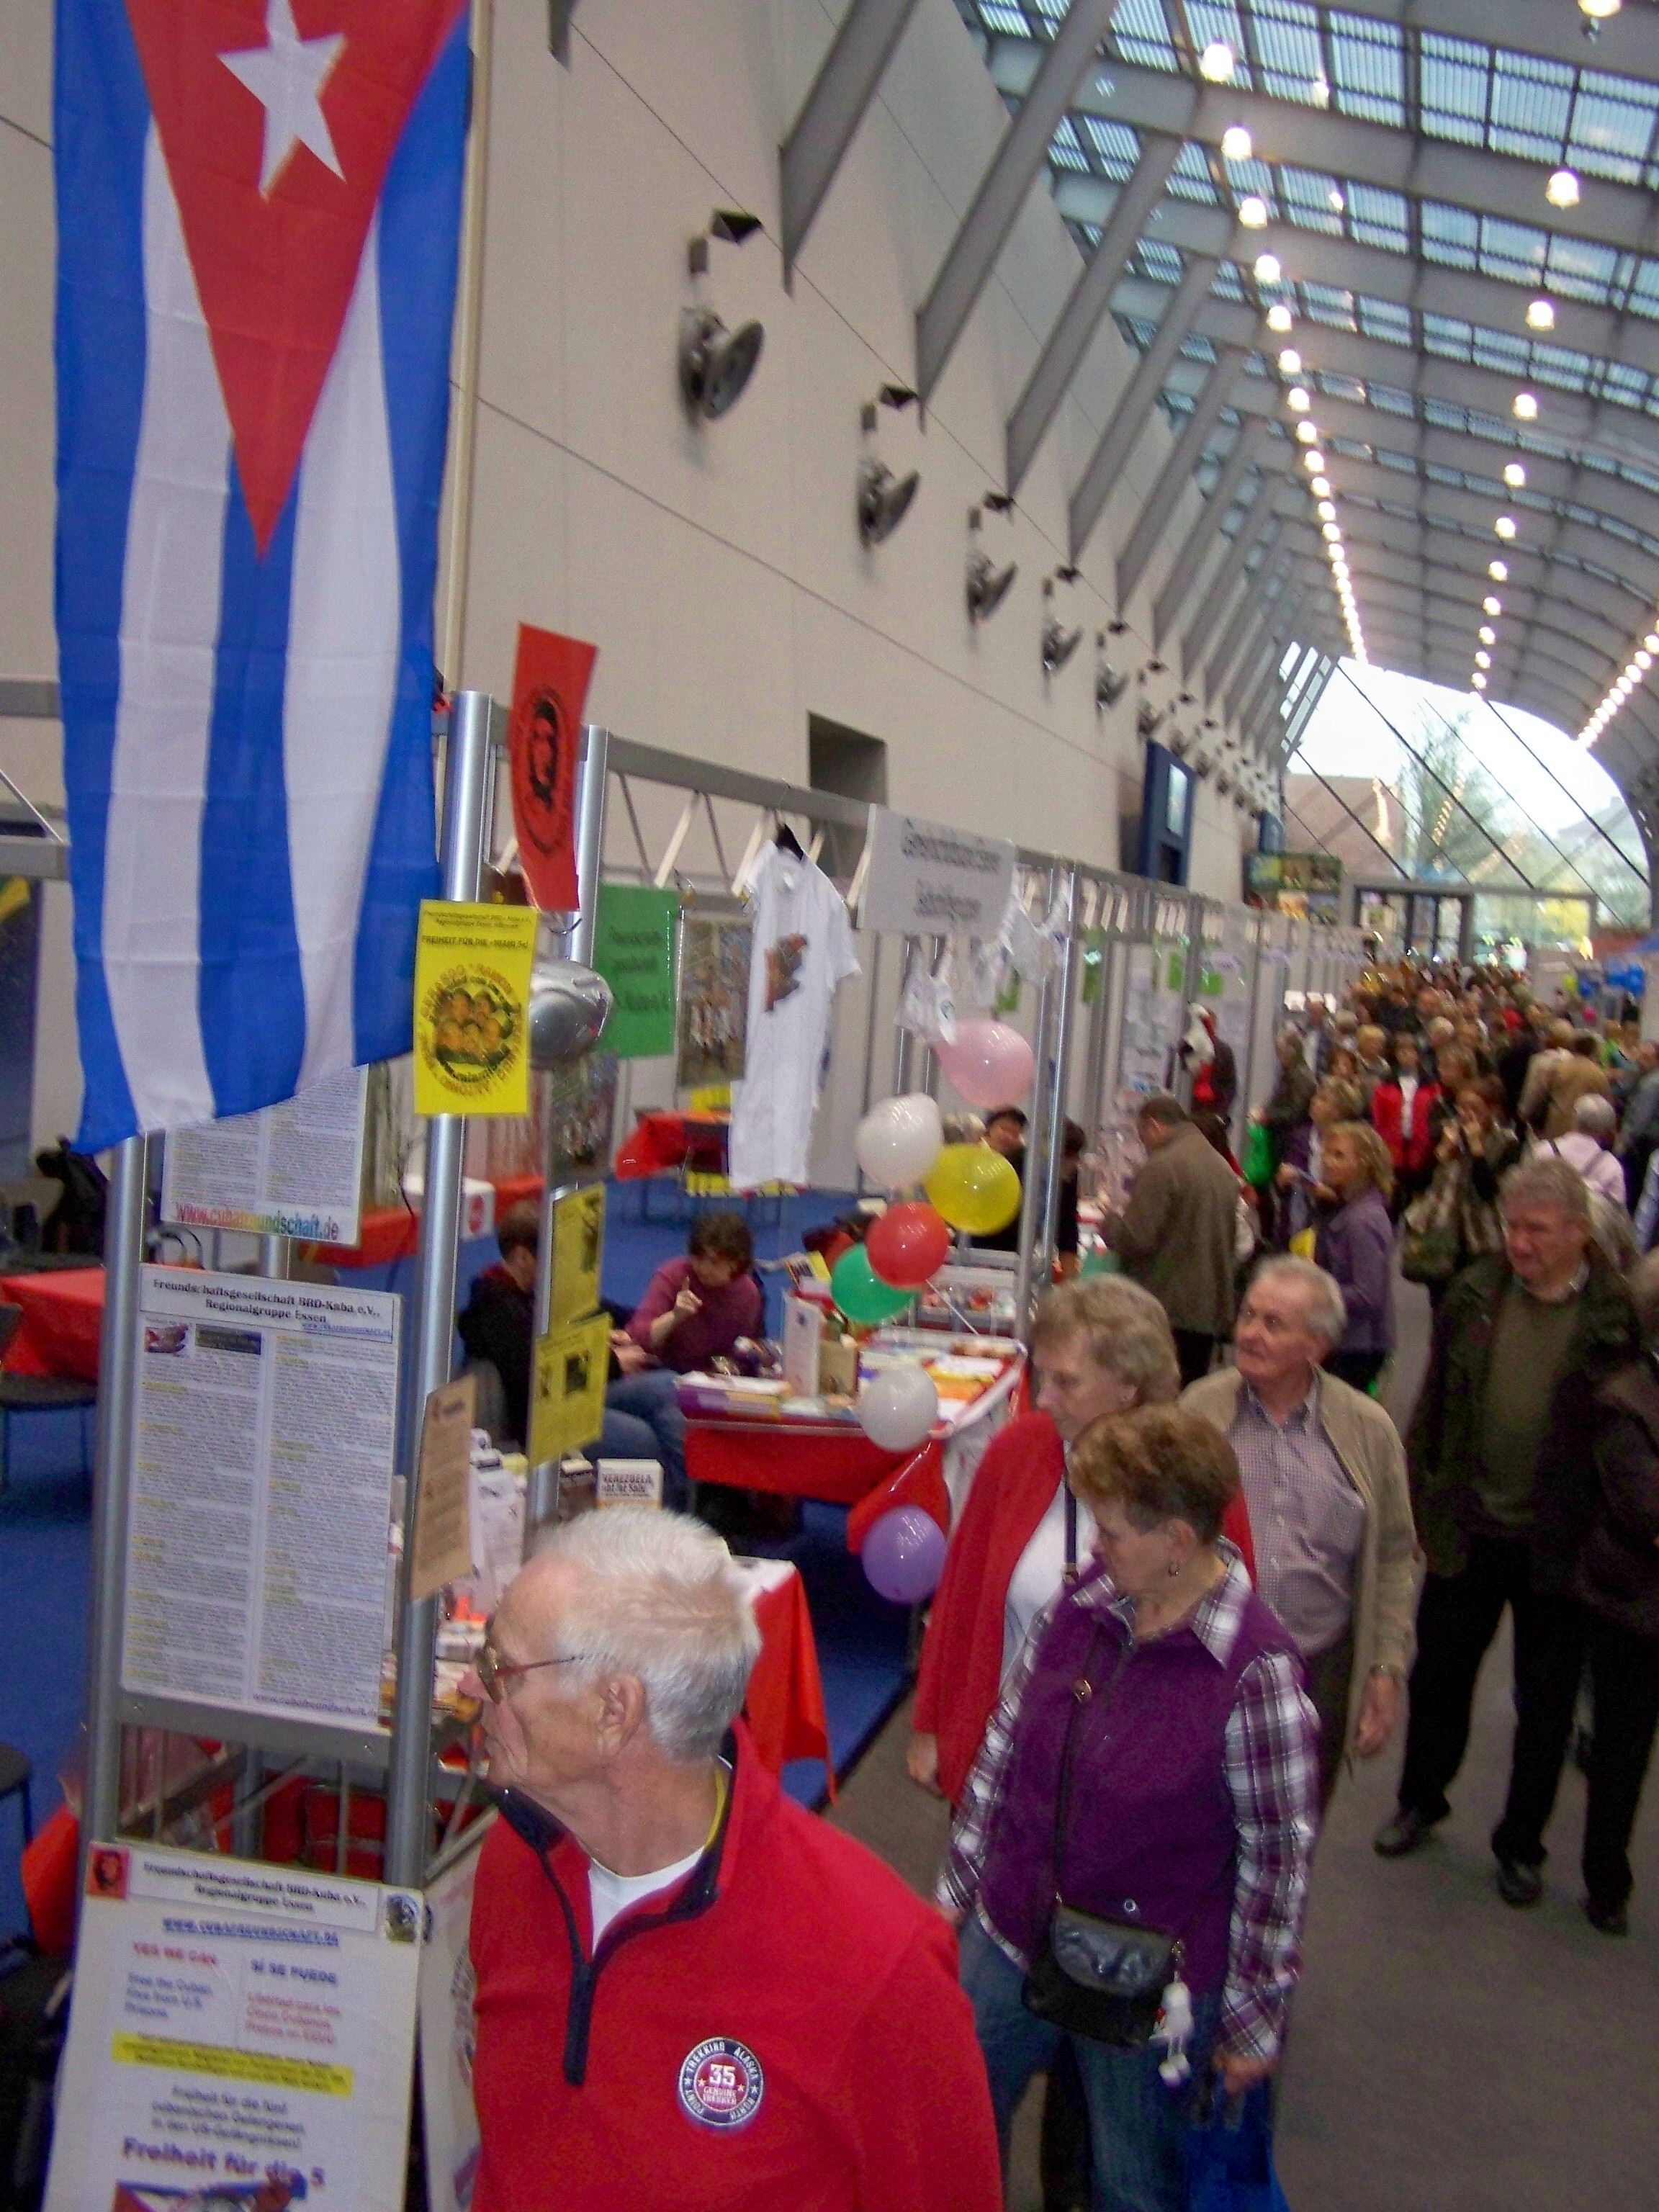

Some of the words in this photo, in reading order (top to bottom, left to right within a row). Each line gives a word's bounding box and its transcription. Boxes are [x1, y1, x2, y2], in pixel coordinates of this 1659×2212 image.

[205, 1298, 292, 1319] Regionalgruppe
[295, 1310, 327, 1323] Essen
[708, 2063, 735, 2087] 35
[122, 2135, 216, 2170] Freiheit
[223, 2151, 257, 2177] für
